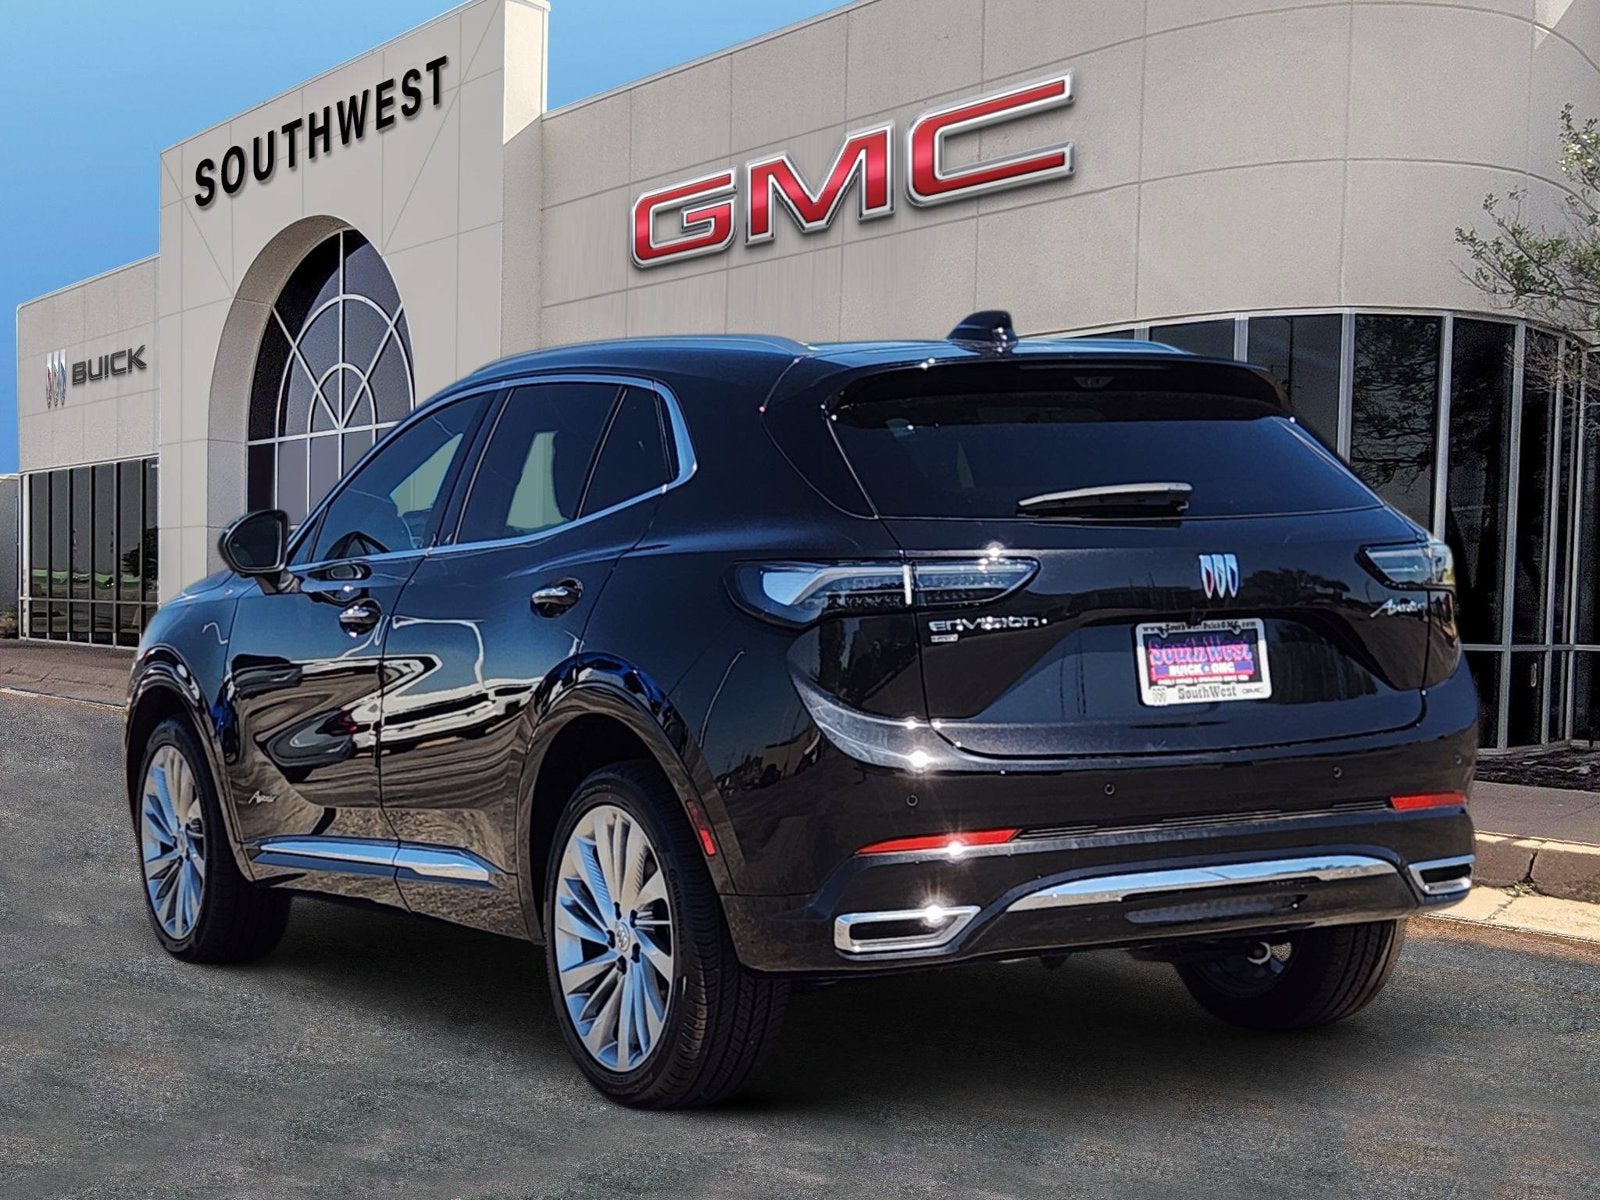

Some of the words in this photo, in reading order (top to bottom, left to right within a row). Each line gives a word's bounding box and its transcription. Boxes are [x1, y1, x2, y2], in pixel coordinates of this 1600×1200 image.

[195, 55, 447, 207] SOUTHWEST
[631, 70, 1075, 268] GMC
[72, 344, 147, 385] BUICK
[1168, 663, 1202, 676] BUICK
[1211, 662, 1235, 675] GMC
